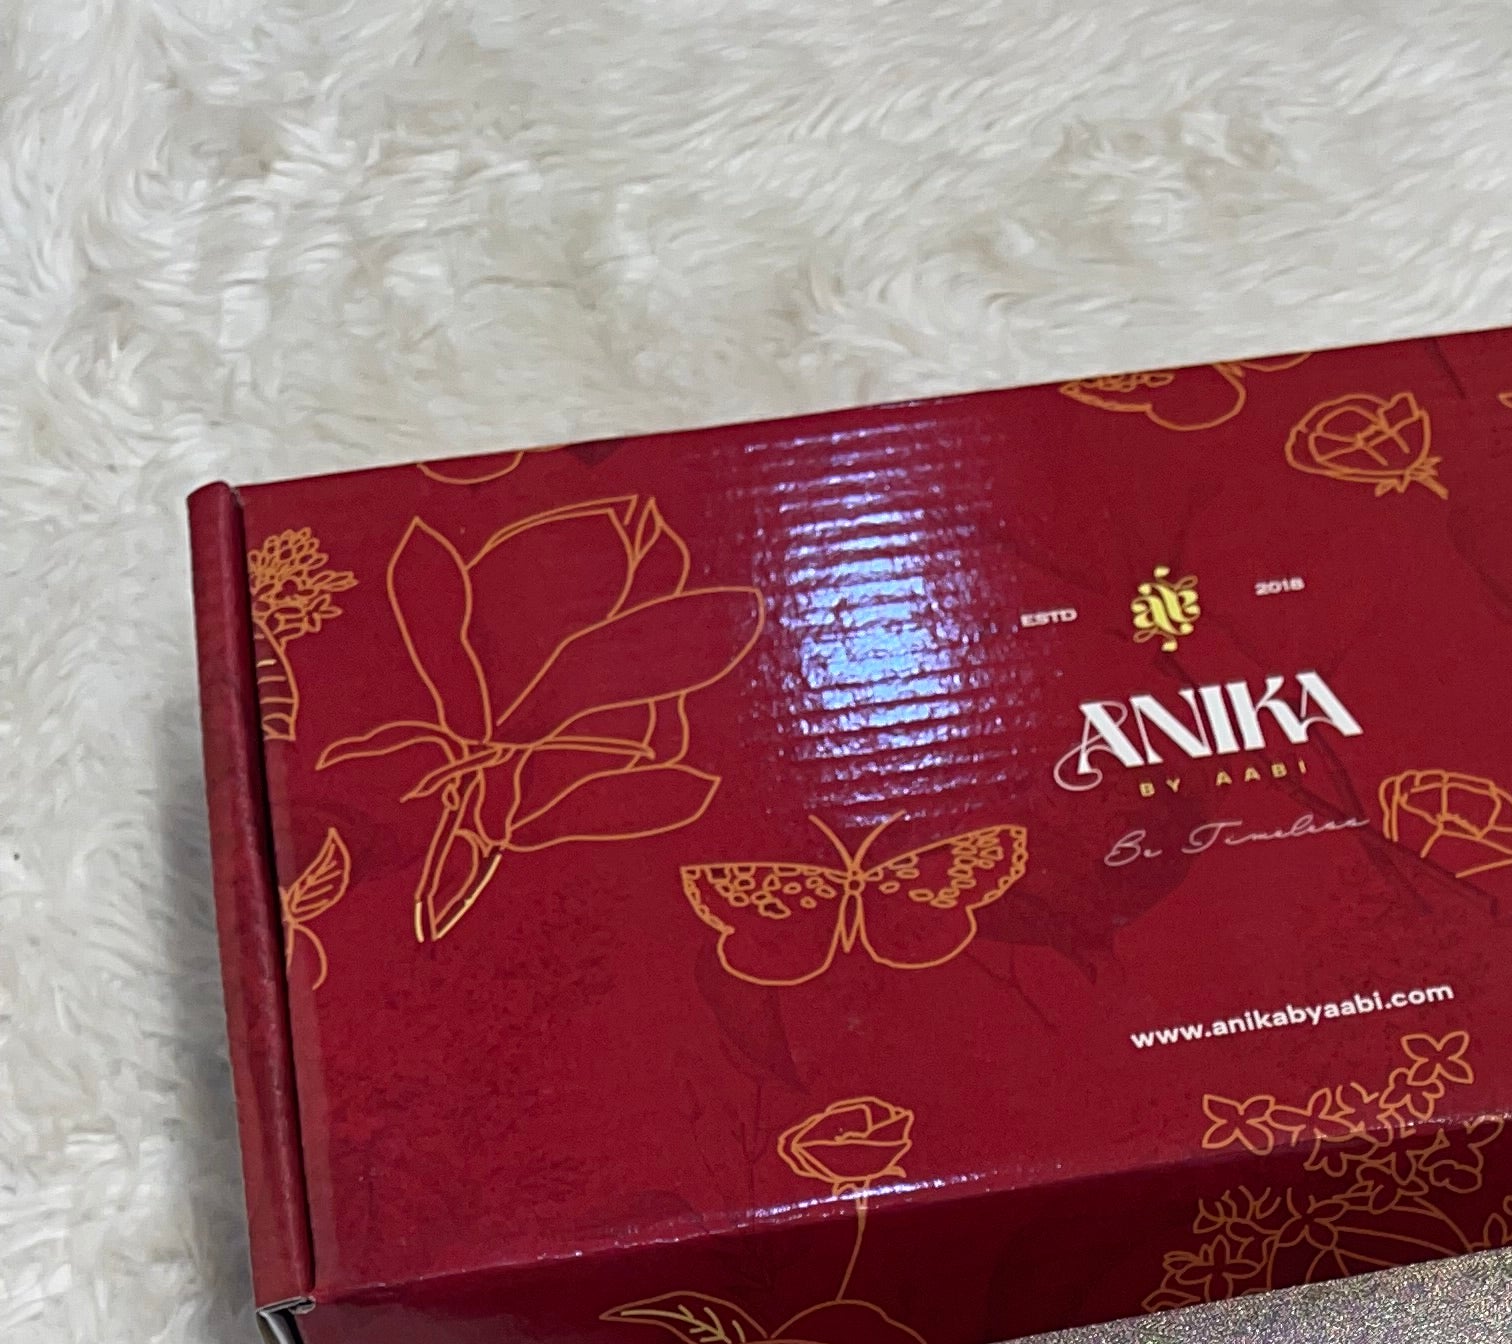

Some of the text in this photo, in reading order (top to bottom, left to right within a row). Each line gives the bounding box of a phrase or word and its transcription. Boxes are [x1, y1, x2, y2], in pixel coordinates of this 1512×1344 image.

[1020, 608, 1077, 628] ESTD
[1053, 670, 1363, 791] ANIKA
[1139, 760, 1306, 797] BY AABI
[1103, 829, 1162, 867] Be
[1130, 984, 1455, 1049] www.anikabyaabi.com
